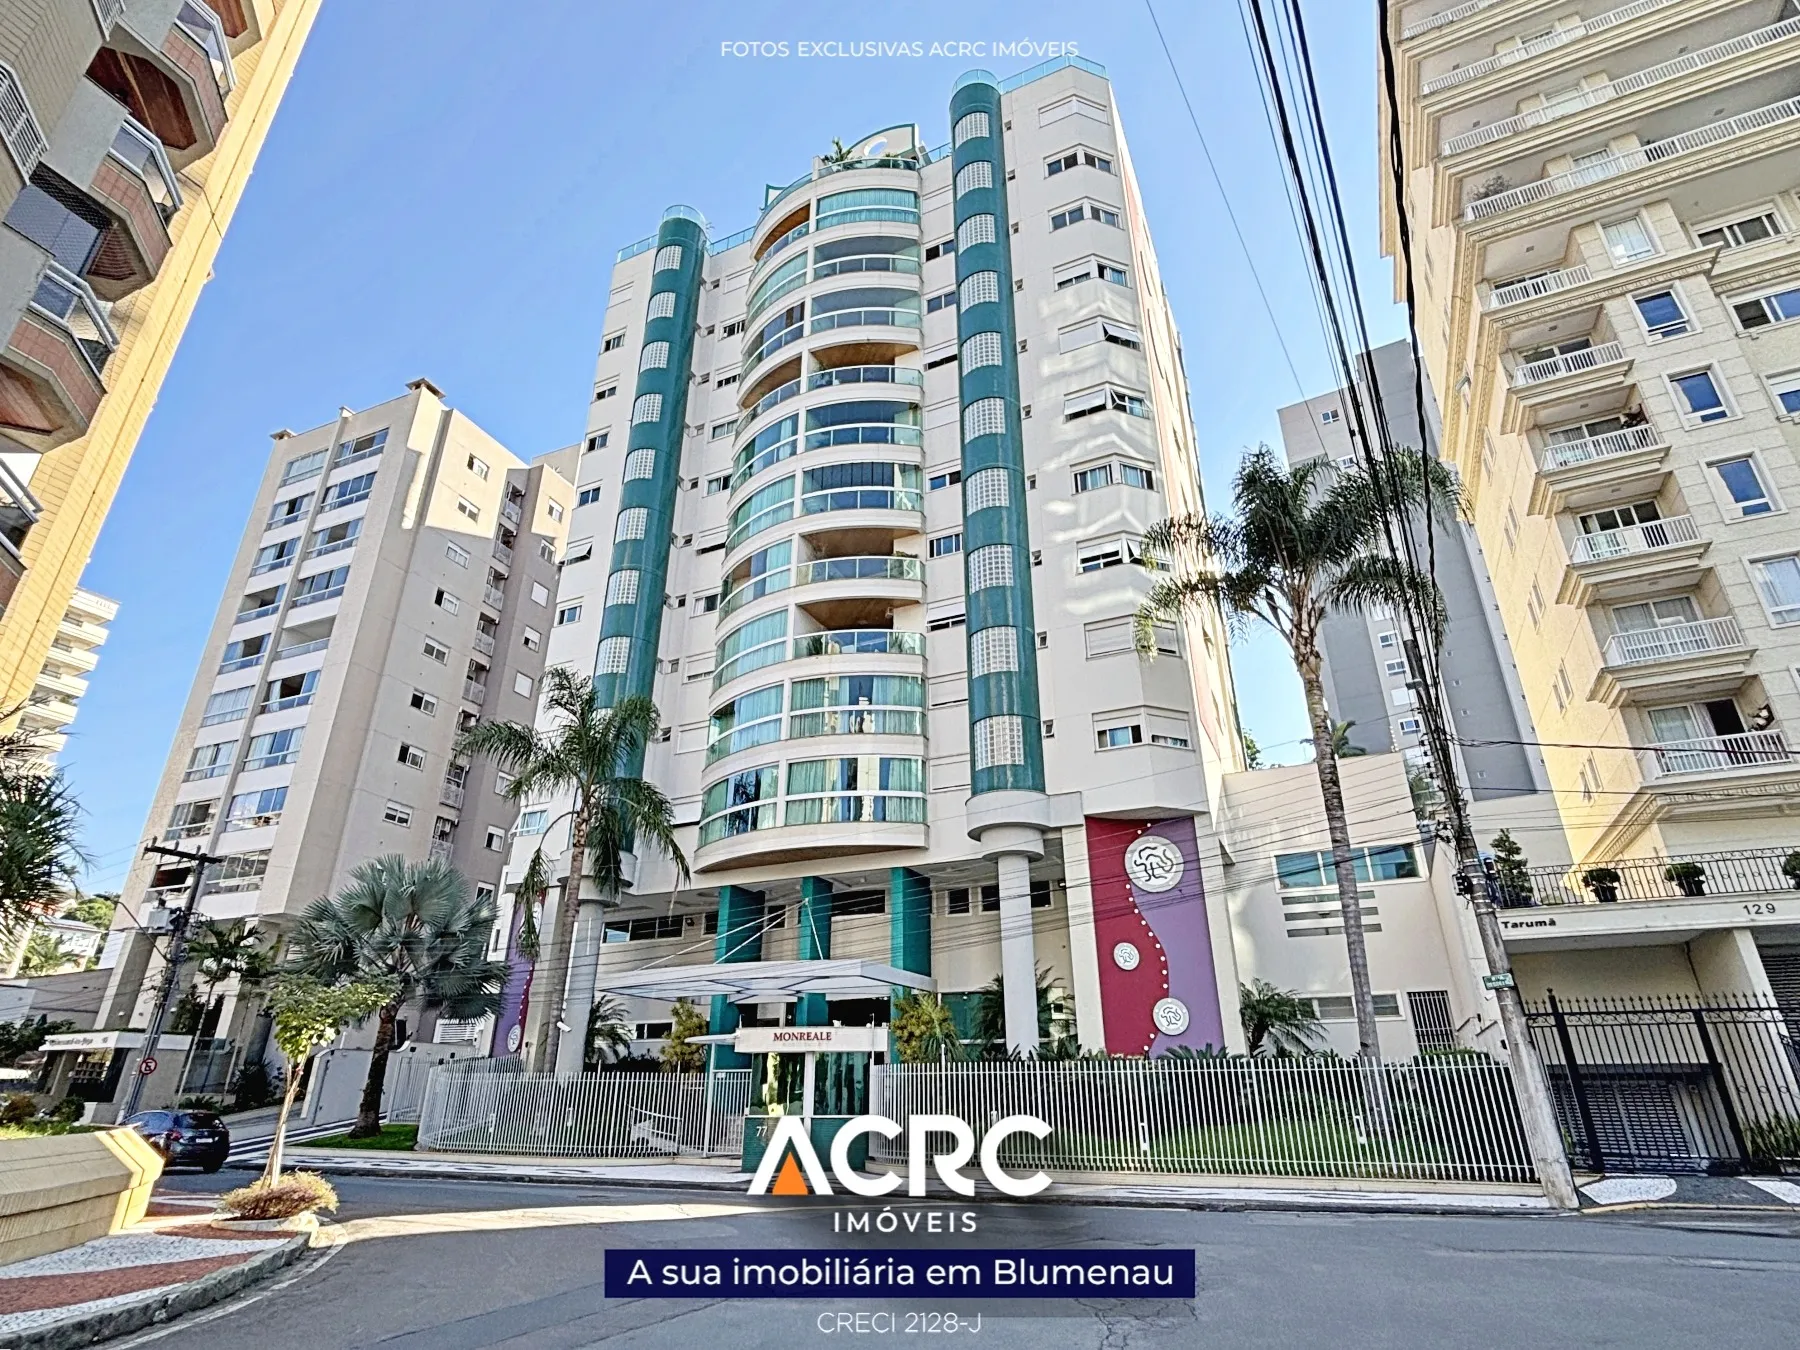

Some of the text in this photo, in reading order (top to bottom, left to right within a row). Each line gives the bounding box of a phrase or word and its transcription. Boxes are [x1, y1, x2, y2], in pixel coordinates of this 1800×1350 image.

[1743, 903, 1776, 915] 129
[1500, 917, 1557, 929] Tarumã
[773, 1031, 832, 1042] MONREALE
